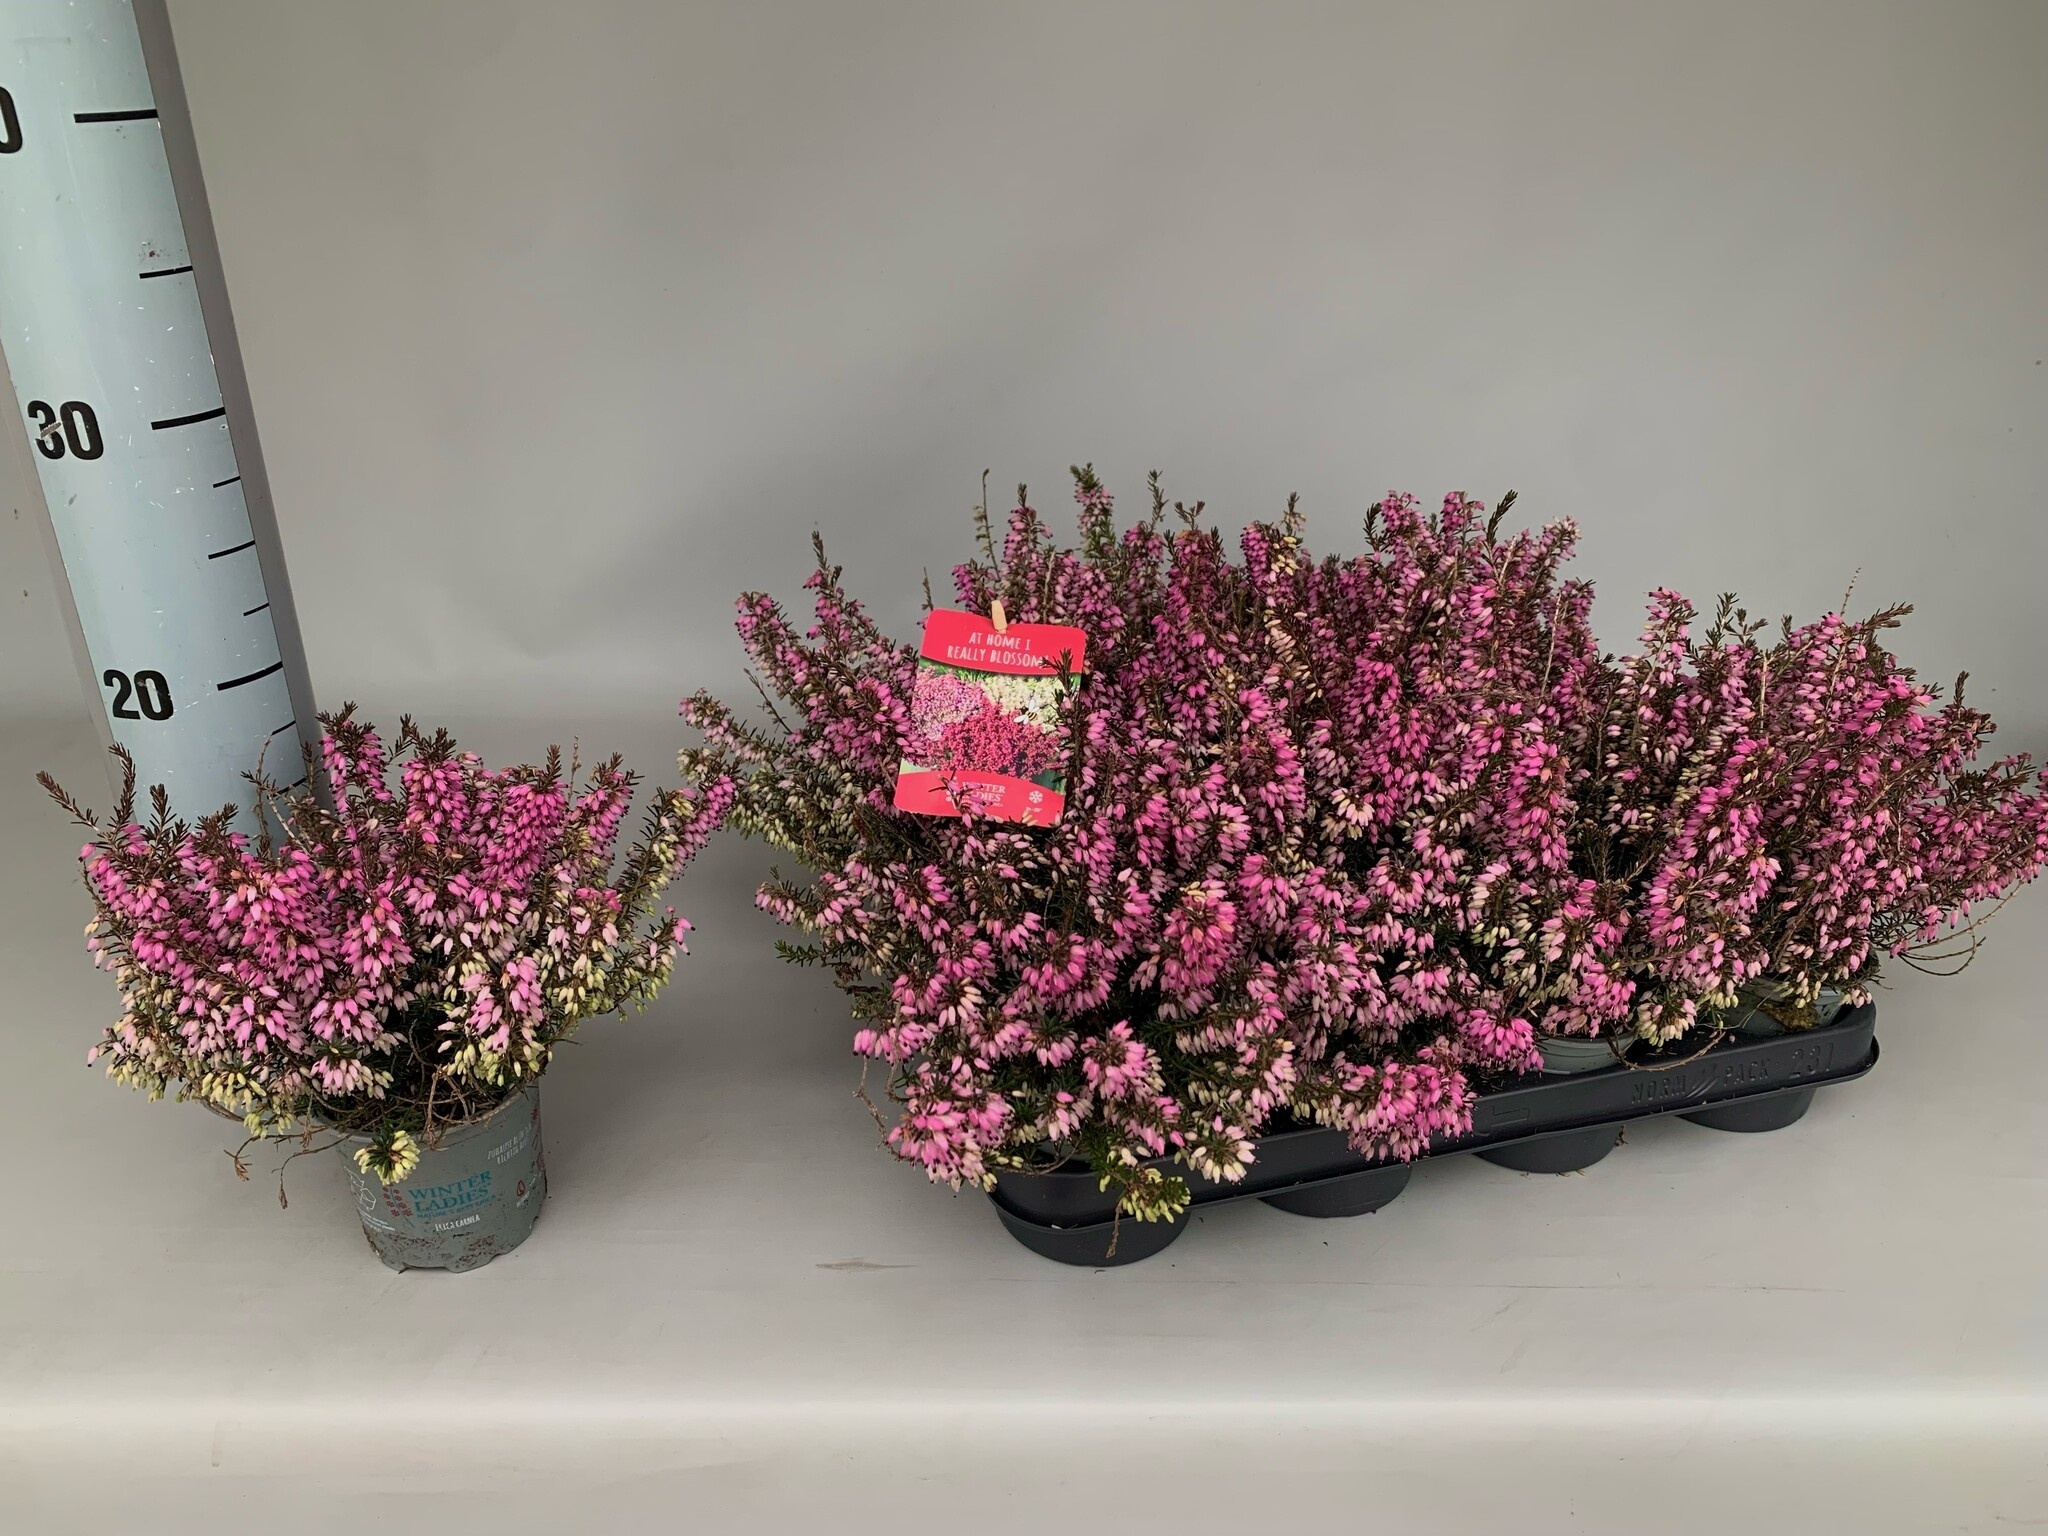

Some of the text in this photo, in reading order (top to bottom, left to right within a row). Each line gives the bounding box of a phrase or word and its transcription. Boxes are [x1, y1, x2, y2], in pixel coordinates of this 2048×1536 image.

[27, 400, 104, 461] 30
[947, 645, 986, 662] REALLY
[968, 632, 1031, 650] AT HOME I
[103, 669, 174, 721] 20
[1723, 1058, 1770, 1087] PACK
[408, 1170, 493, 1200] WINTER
[415, 1185, 489, 1213] LADIES
